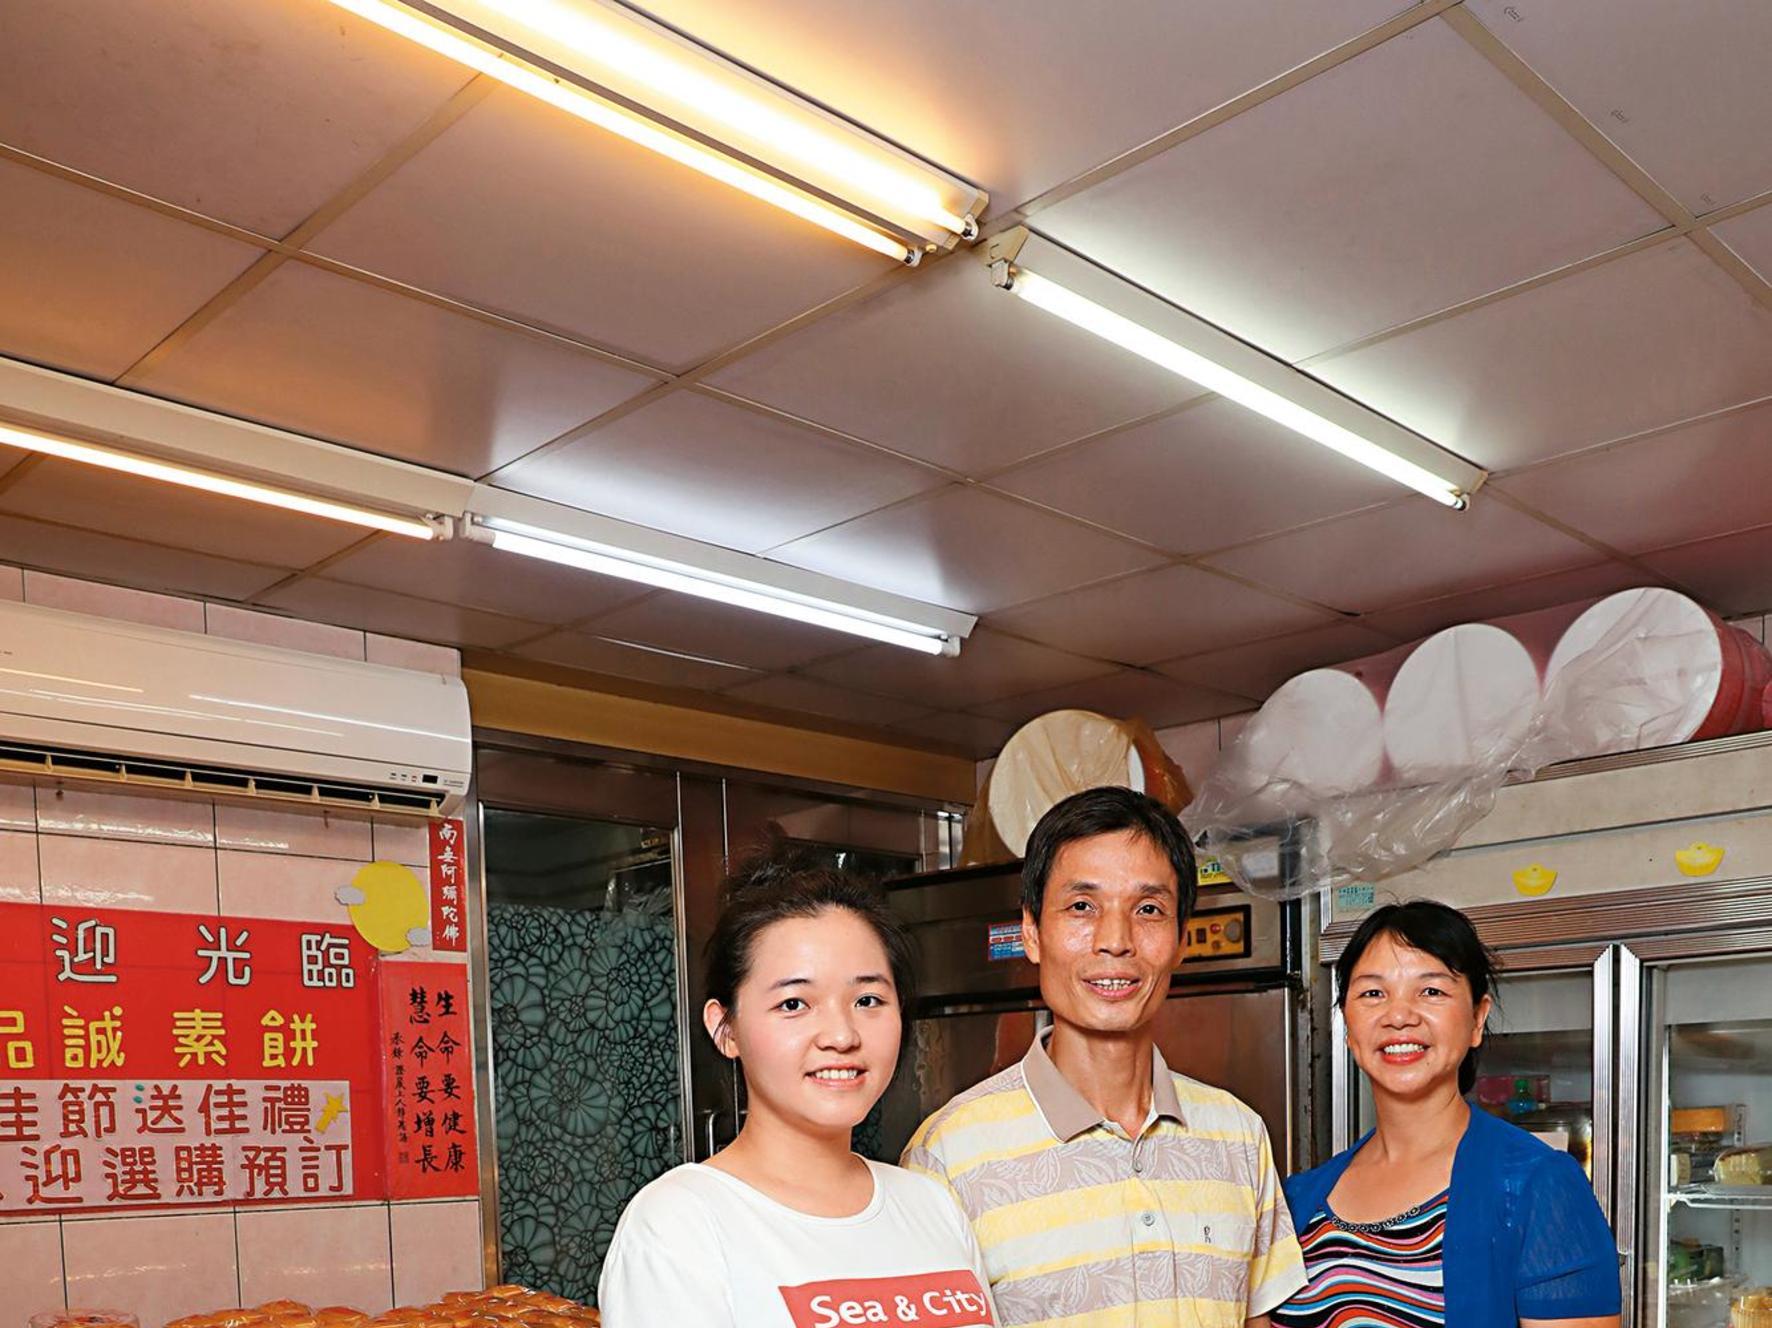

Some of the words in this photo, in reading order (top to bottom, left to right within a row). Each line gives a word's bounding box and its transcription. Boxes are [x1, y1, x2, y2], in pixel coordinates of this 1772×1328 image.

[51, 917, 356, 988] 迎光臨
[409, 985, 441, 1173] 慧命要增長
[435, 989, 467, 1173] 生命要健康
[0, 1136, 350, 1204] 迎選購預訂
[894, 1295, 919, 1322] &
[922, 1289, 986, 1317] City
